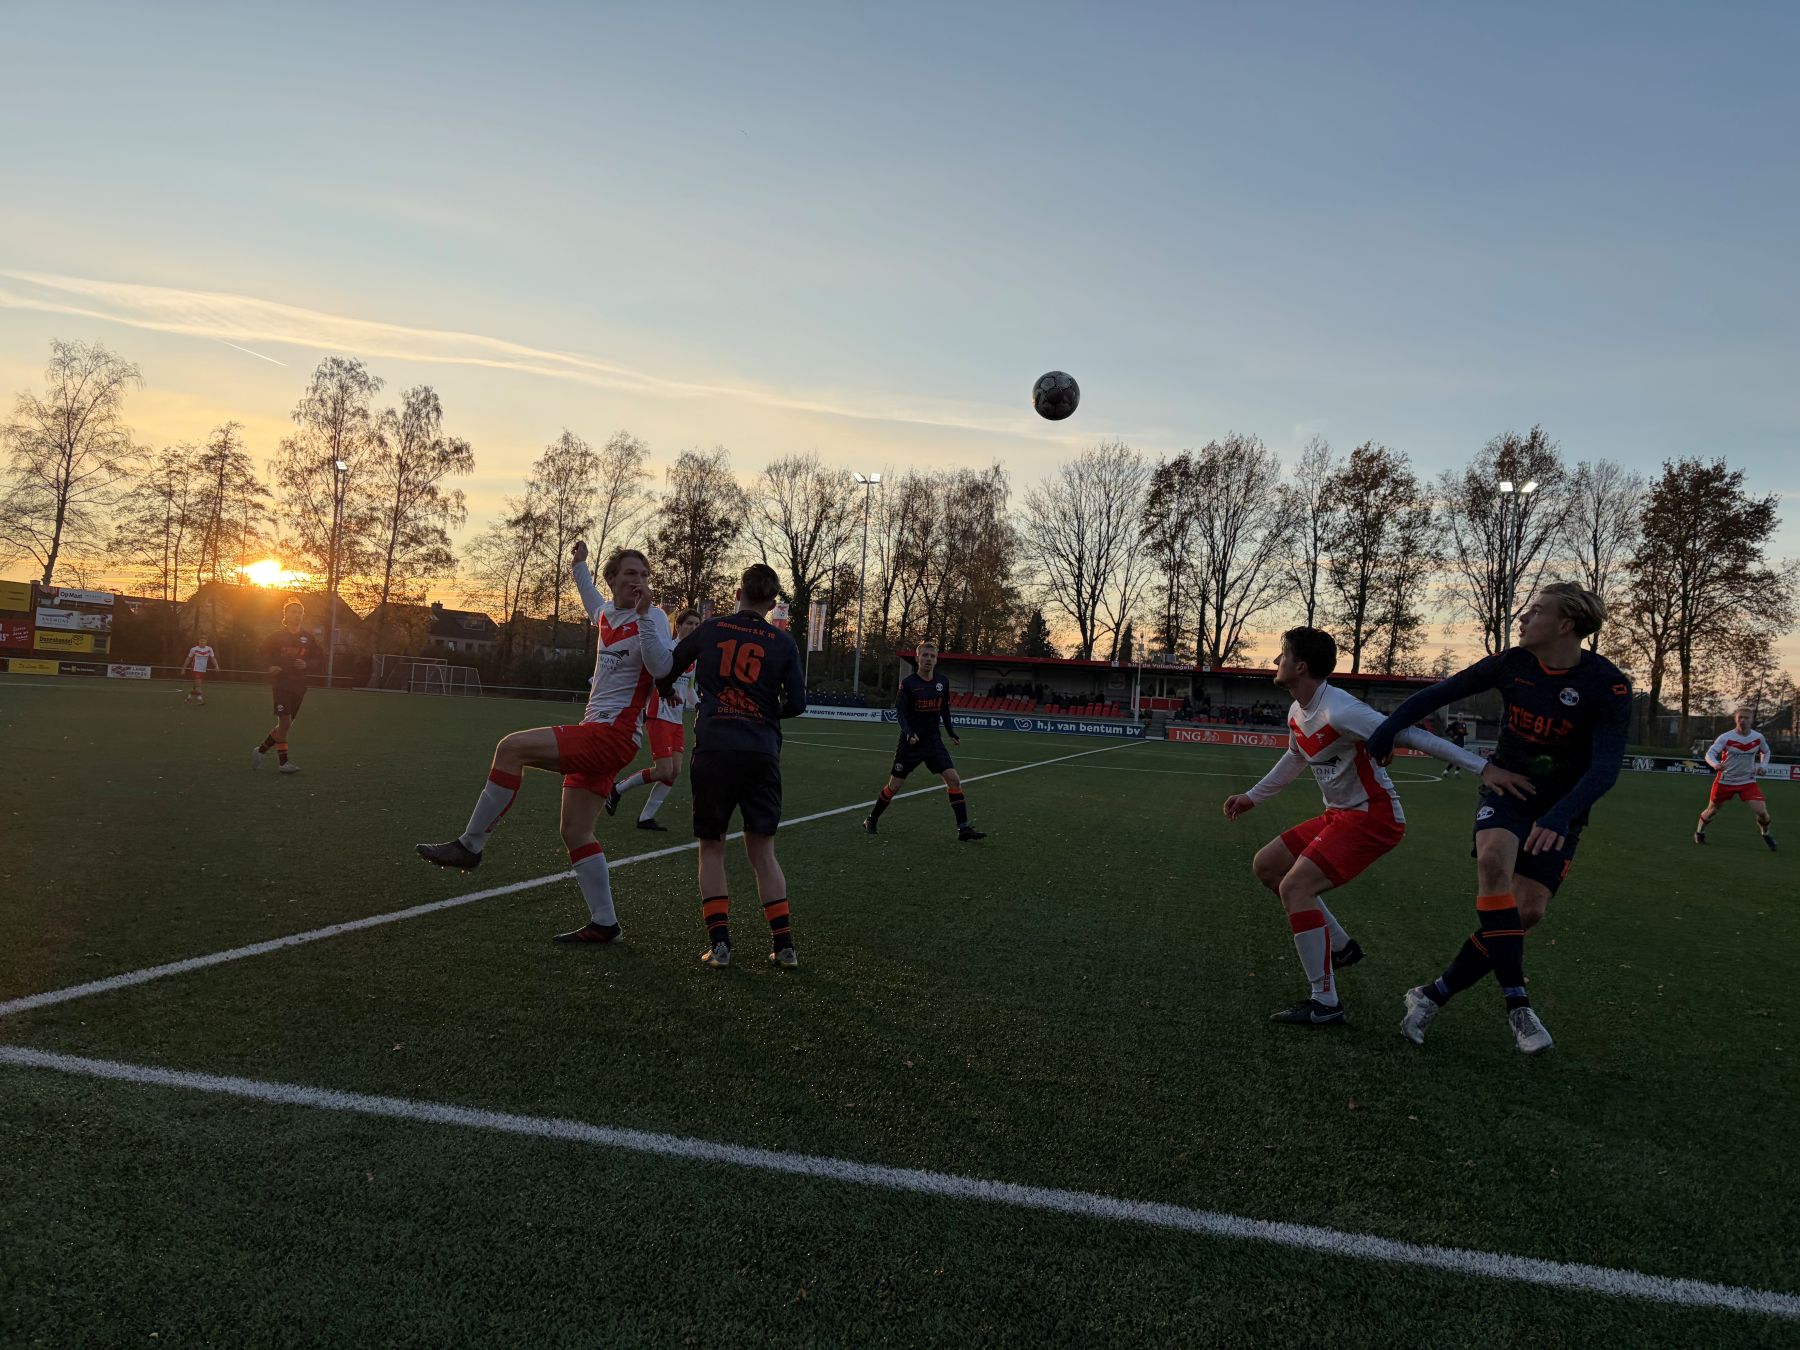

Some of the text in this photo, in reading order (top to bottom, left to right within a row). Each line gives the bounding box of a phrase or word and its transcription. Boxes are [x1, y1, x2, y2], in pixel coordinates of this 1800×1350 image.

[715, 638, 766, 685] 16
[991, 719, 1004, 727] bv
[1036, 721, 1141, 736] h.j. van bentum bv
[1175, 730, 1258, 745] ING ING
